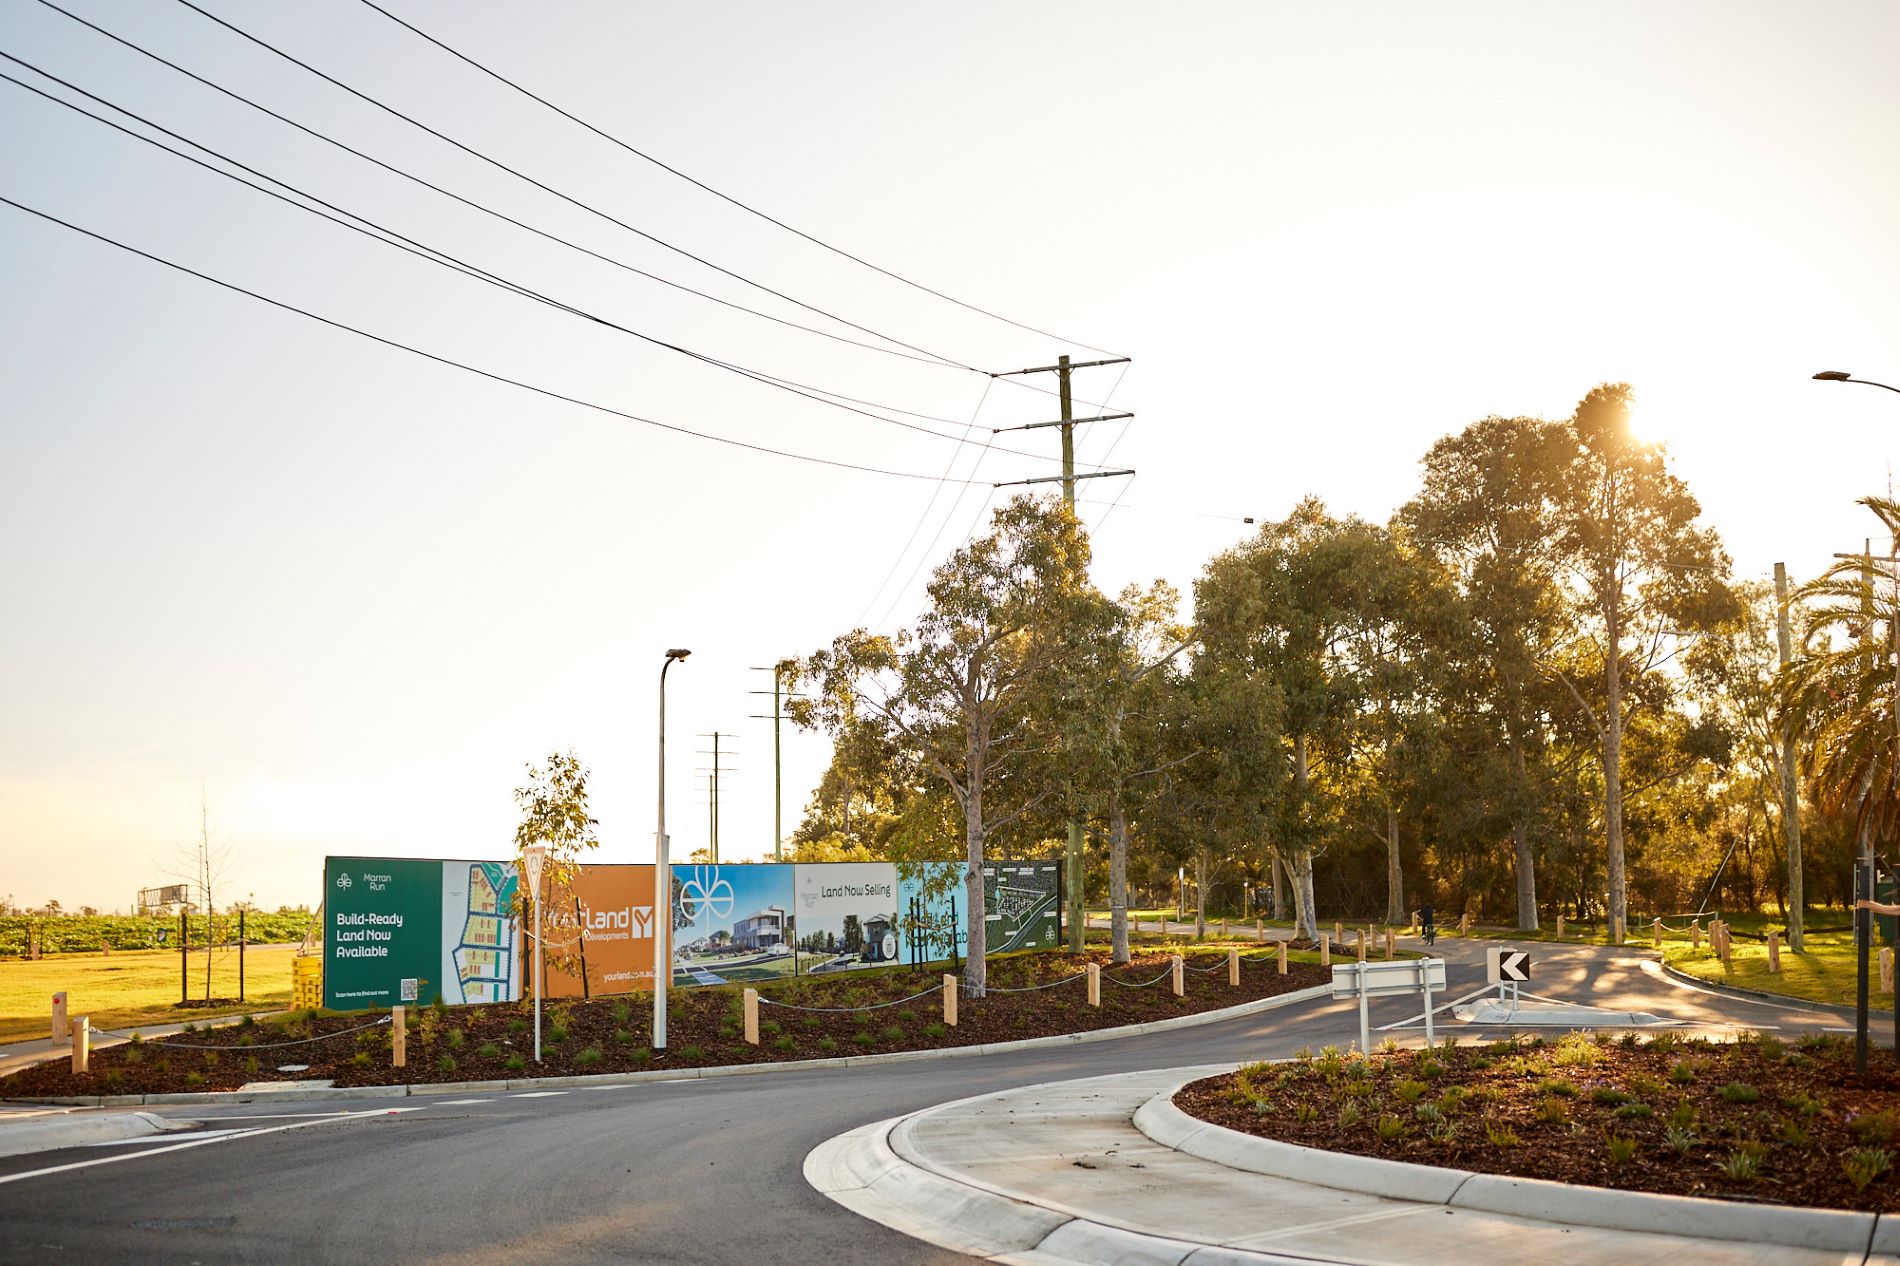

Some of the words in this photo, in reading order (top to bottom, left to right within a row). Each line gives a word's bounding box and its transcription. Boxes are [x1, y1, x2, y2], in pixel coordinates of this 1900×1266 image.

[363, 873, 392, 882] Marran
[369, 882, 386, 891] Run
[821, 885, 843, 898] Land
[844, 884, 864, 897] Now
[864, 883, 891, 898] Selling
[336, 913, 403, 927] Build-Ready
[336, 929, 365, 942] Land
[366, 929, 392, 941] Now
[336, 945, 388, 958] Available
